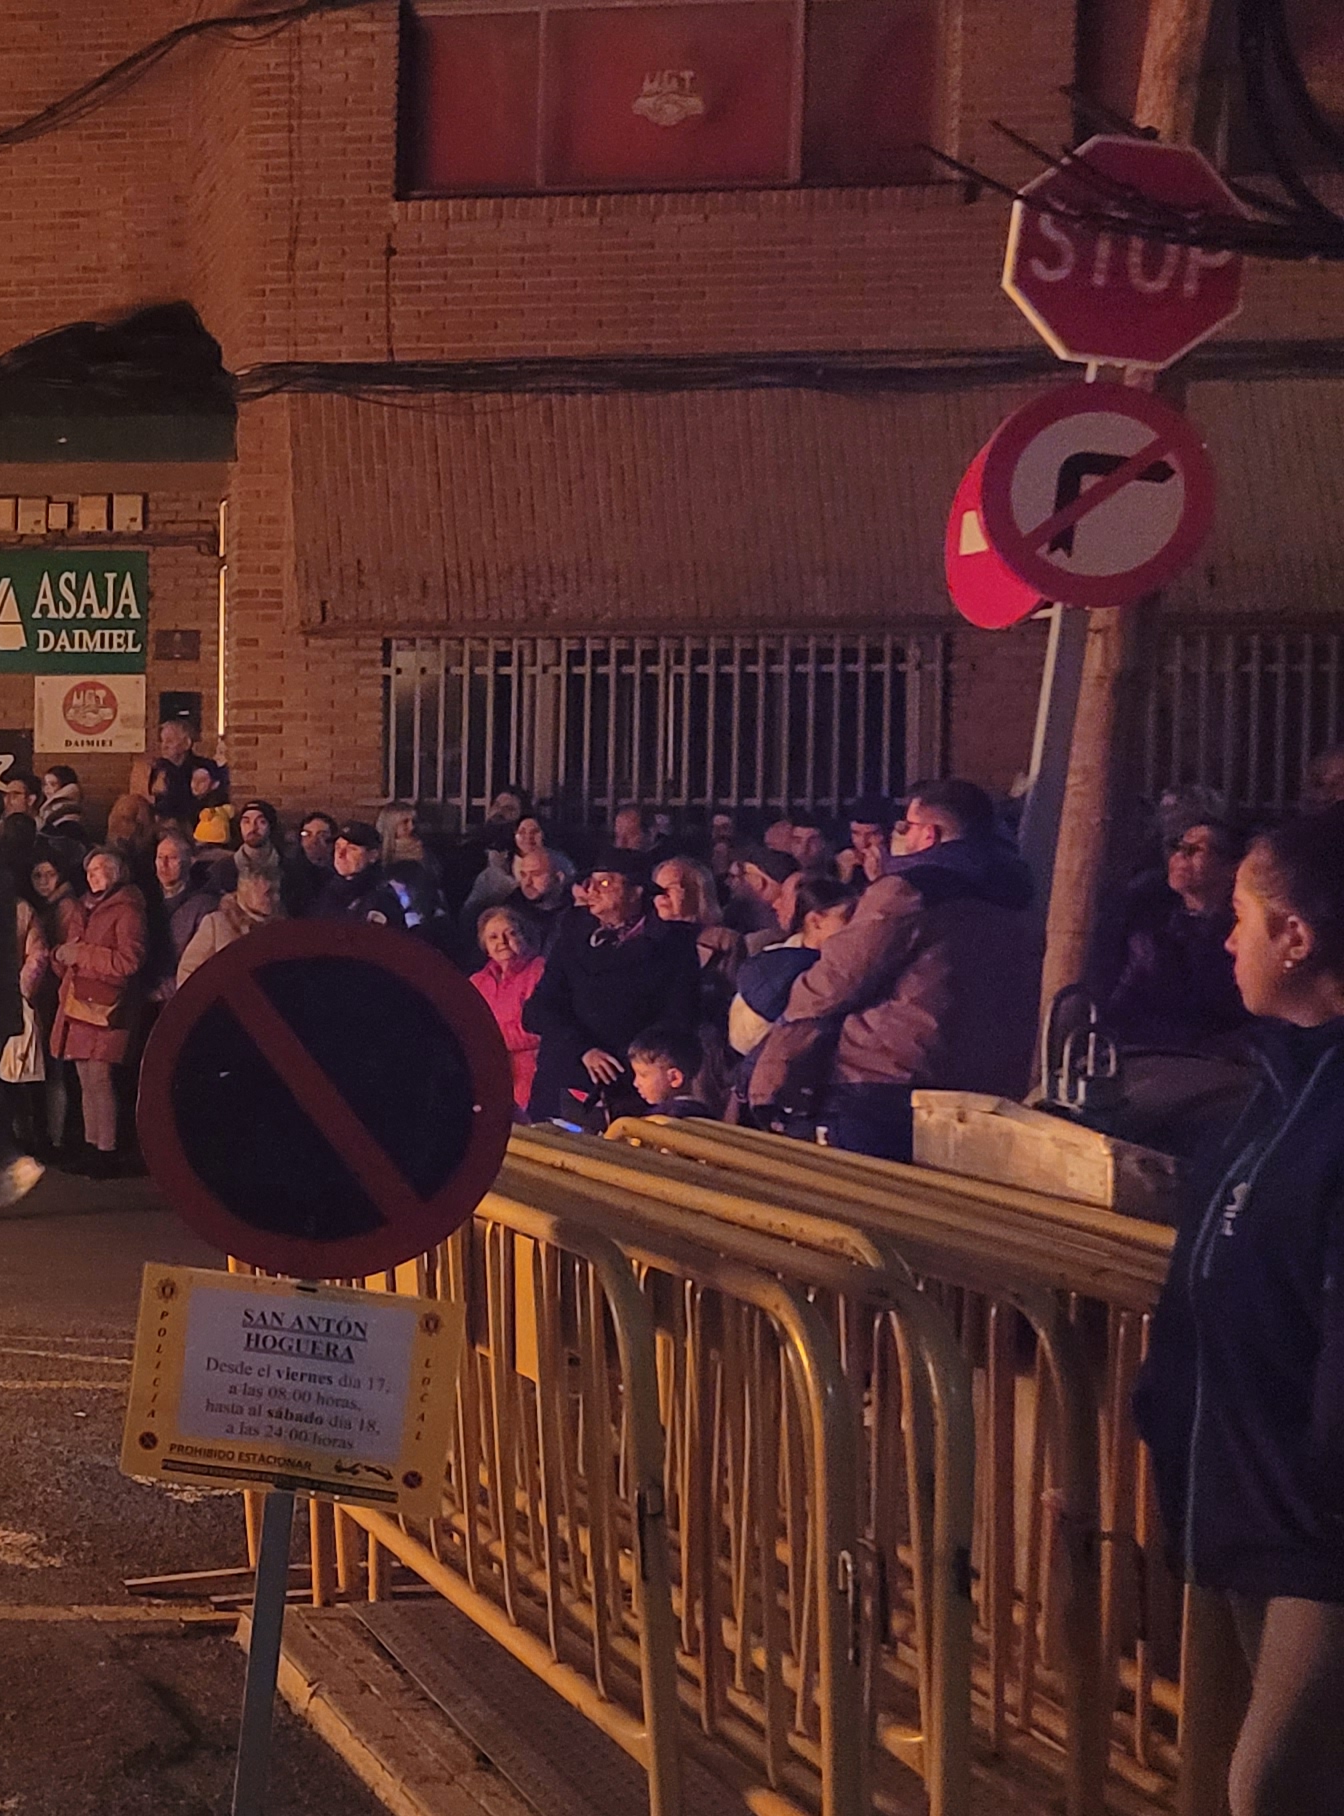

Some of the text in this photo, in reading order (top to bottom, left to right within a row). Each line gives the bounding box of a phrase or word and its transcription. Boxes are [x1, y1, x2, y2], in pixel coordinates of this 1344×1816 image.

[31, 571, 141, 619] ASAJA
[36, 629, 142, 653] DAIMIEL
[243, 1307, 368, 1338] SAN ANTÓN
[245, 1332, 354, 1361] HOGUERA
[206, 1357, 252, 1376] Desde
[258, 1365, 271, 1378] el
[276, 1367, 333, 1385] viernes
[229, 1385, 237, 1395] a
[243, 1383, 263, 1398] las
[415, 1358, 431, 1441] LOCAL
[205, 1399, 244, 1416] hasta
[248, 1404, 262, 1417] al
[267, 1406, 323, 1425] sábado
[226, 1424, 234, 1434] a
[239, 1421, 259, 1436] las
[264, 1425, 308, 1442] 24:00
[169, 1443, 312, 1472] PROHIBIDO ESTACIONAR
